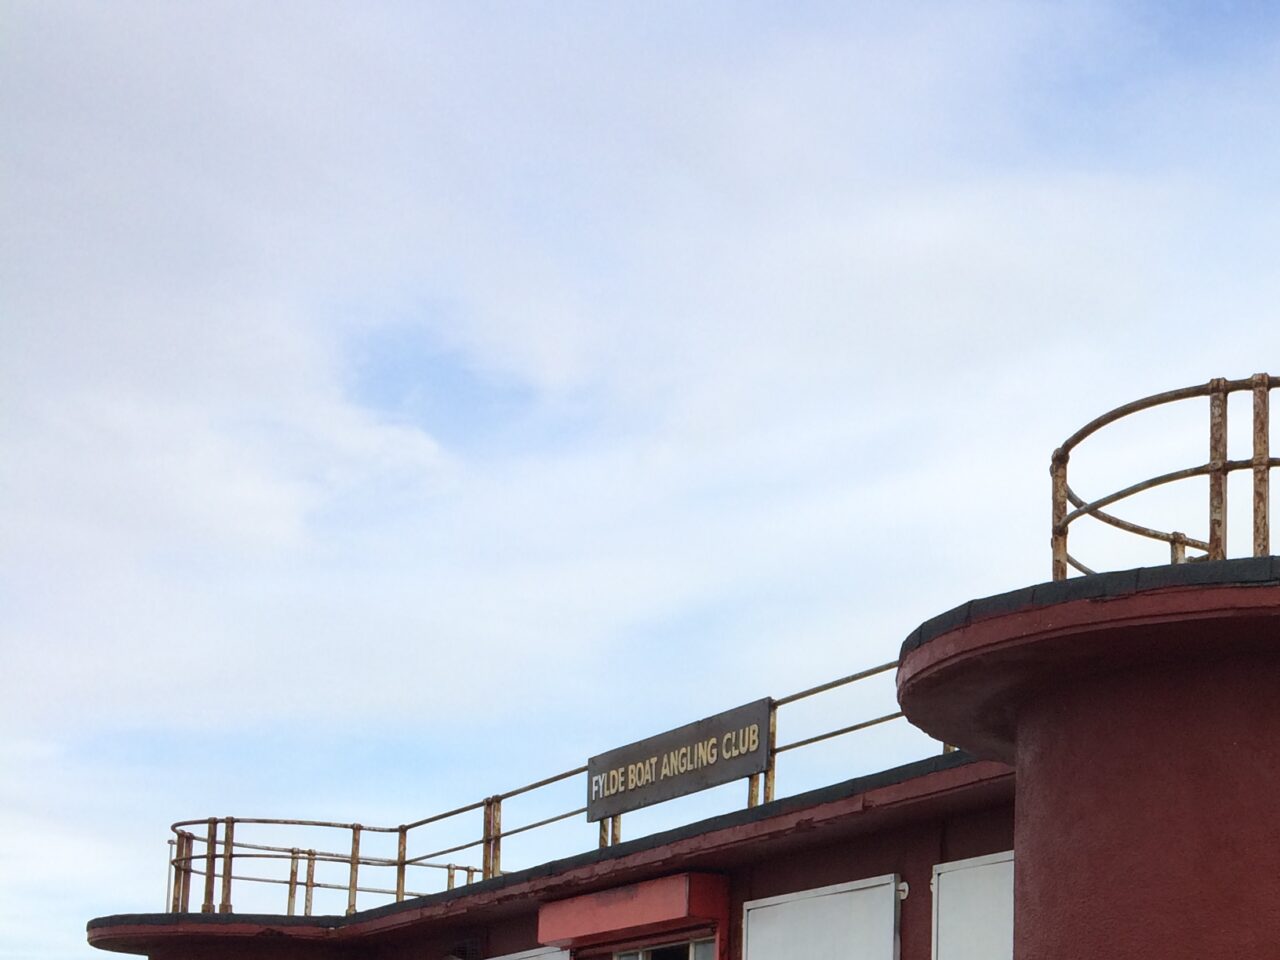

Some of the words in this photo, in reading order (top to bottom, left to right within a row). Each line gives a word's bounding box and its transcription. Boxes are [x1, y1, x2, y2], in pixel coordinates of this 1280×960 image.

[592, 767, 625, 801] FYLDE
[627, 757, 658, 790] BOAT
[660, 737, 718, 780] ANGLING
[722, 723, 759, 760] CLUB
